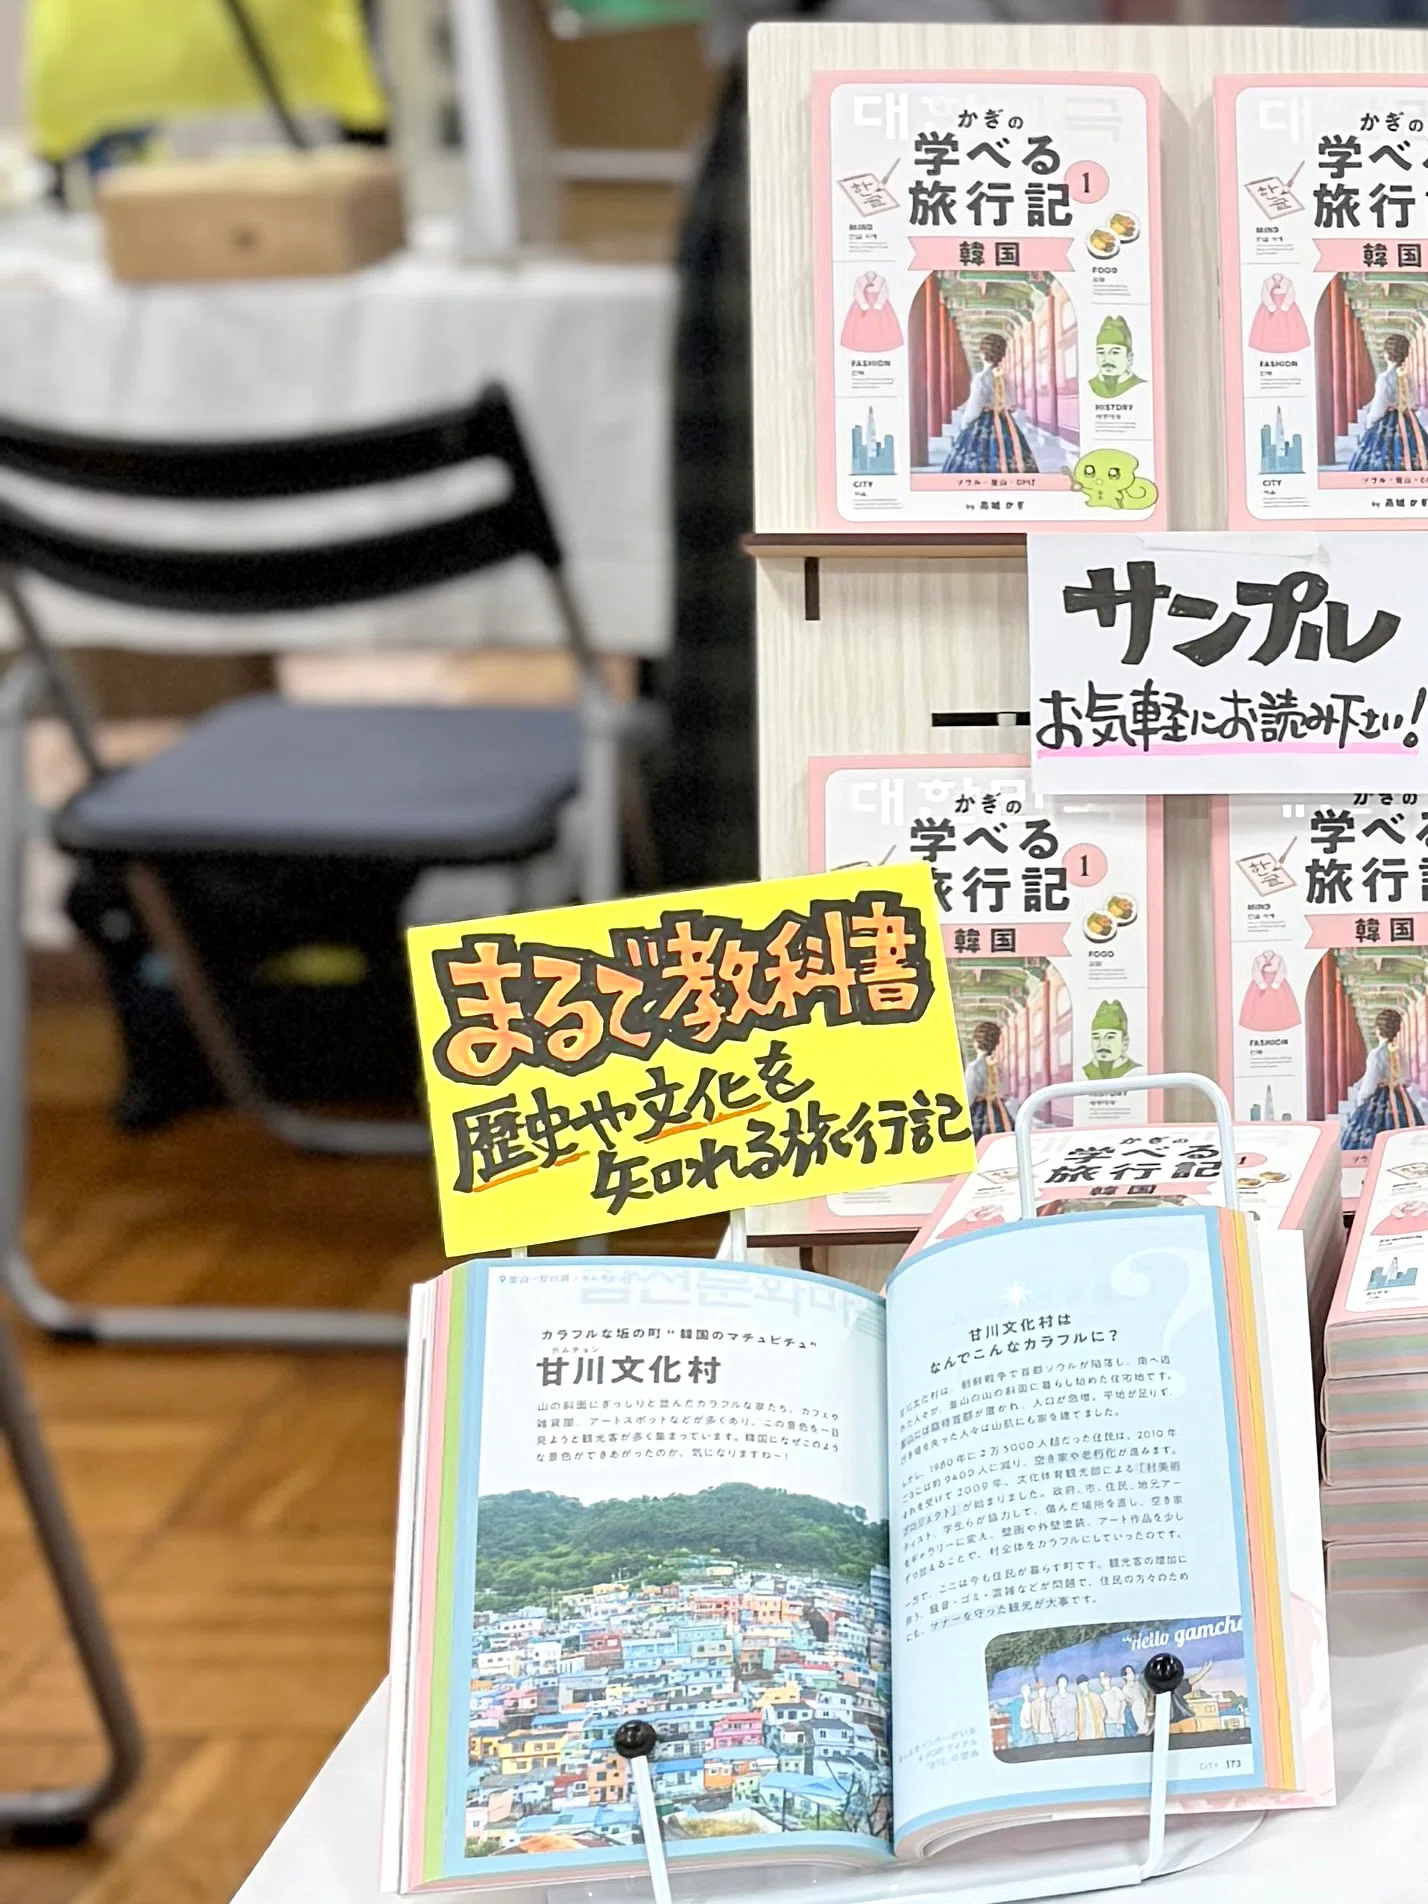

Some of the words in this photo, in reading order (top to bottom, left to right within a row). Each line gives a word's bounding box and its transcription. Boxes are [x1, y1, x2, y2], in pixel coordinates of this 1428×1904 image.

[958, 109, 1023, 129] かぎの
[1360, 112, 1423, 132] かぎの
[914, 132, 1060, 176] 学べる
[909, 181, 1073, 227] 旅行記
[959, 242, 1020, 266] 韓国
[1363, 244, 1422, 267] 韓国
[1063, 561, 1401, 667] サンプル
[1036, 678, 1427, 751] お気軽にお読み下さい！
[955, 793, 1022, 814] かぎの
[910, 817, 1059, 861] 学べる
[954, 928, 1016, 952] 韓国
[433, 891, 934, 1085] まるで教科書
[454, 1041, 815, 1193] 歴史や文化を
[592, 1091, 972, 1215] 知れる旅行記
[969, 1314, 1072, 1342] 甘川文化村は
[930, 1329, 1118, 1374] なんでこんなカラフルに？
[536, 1355, 722, 1386] 甘川文化村
[1226, 1759, 1242, 1769] 173
